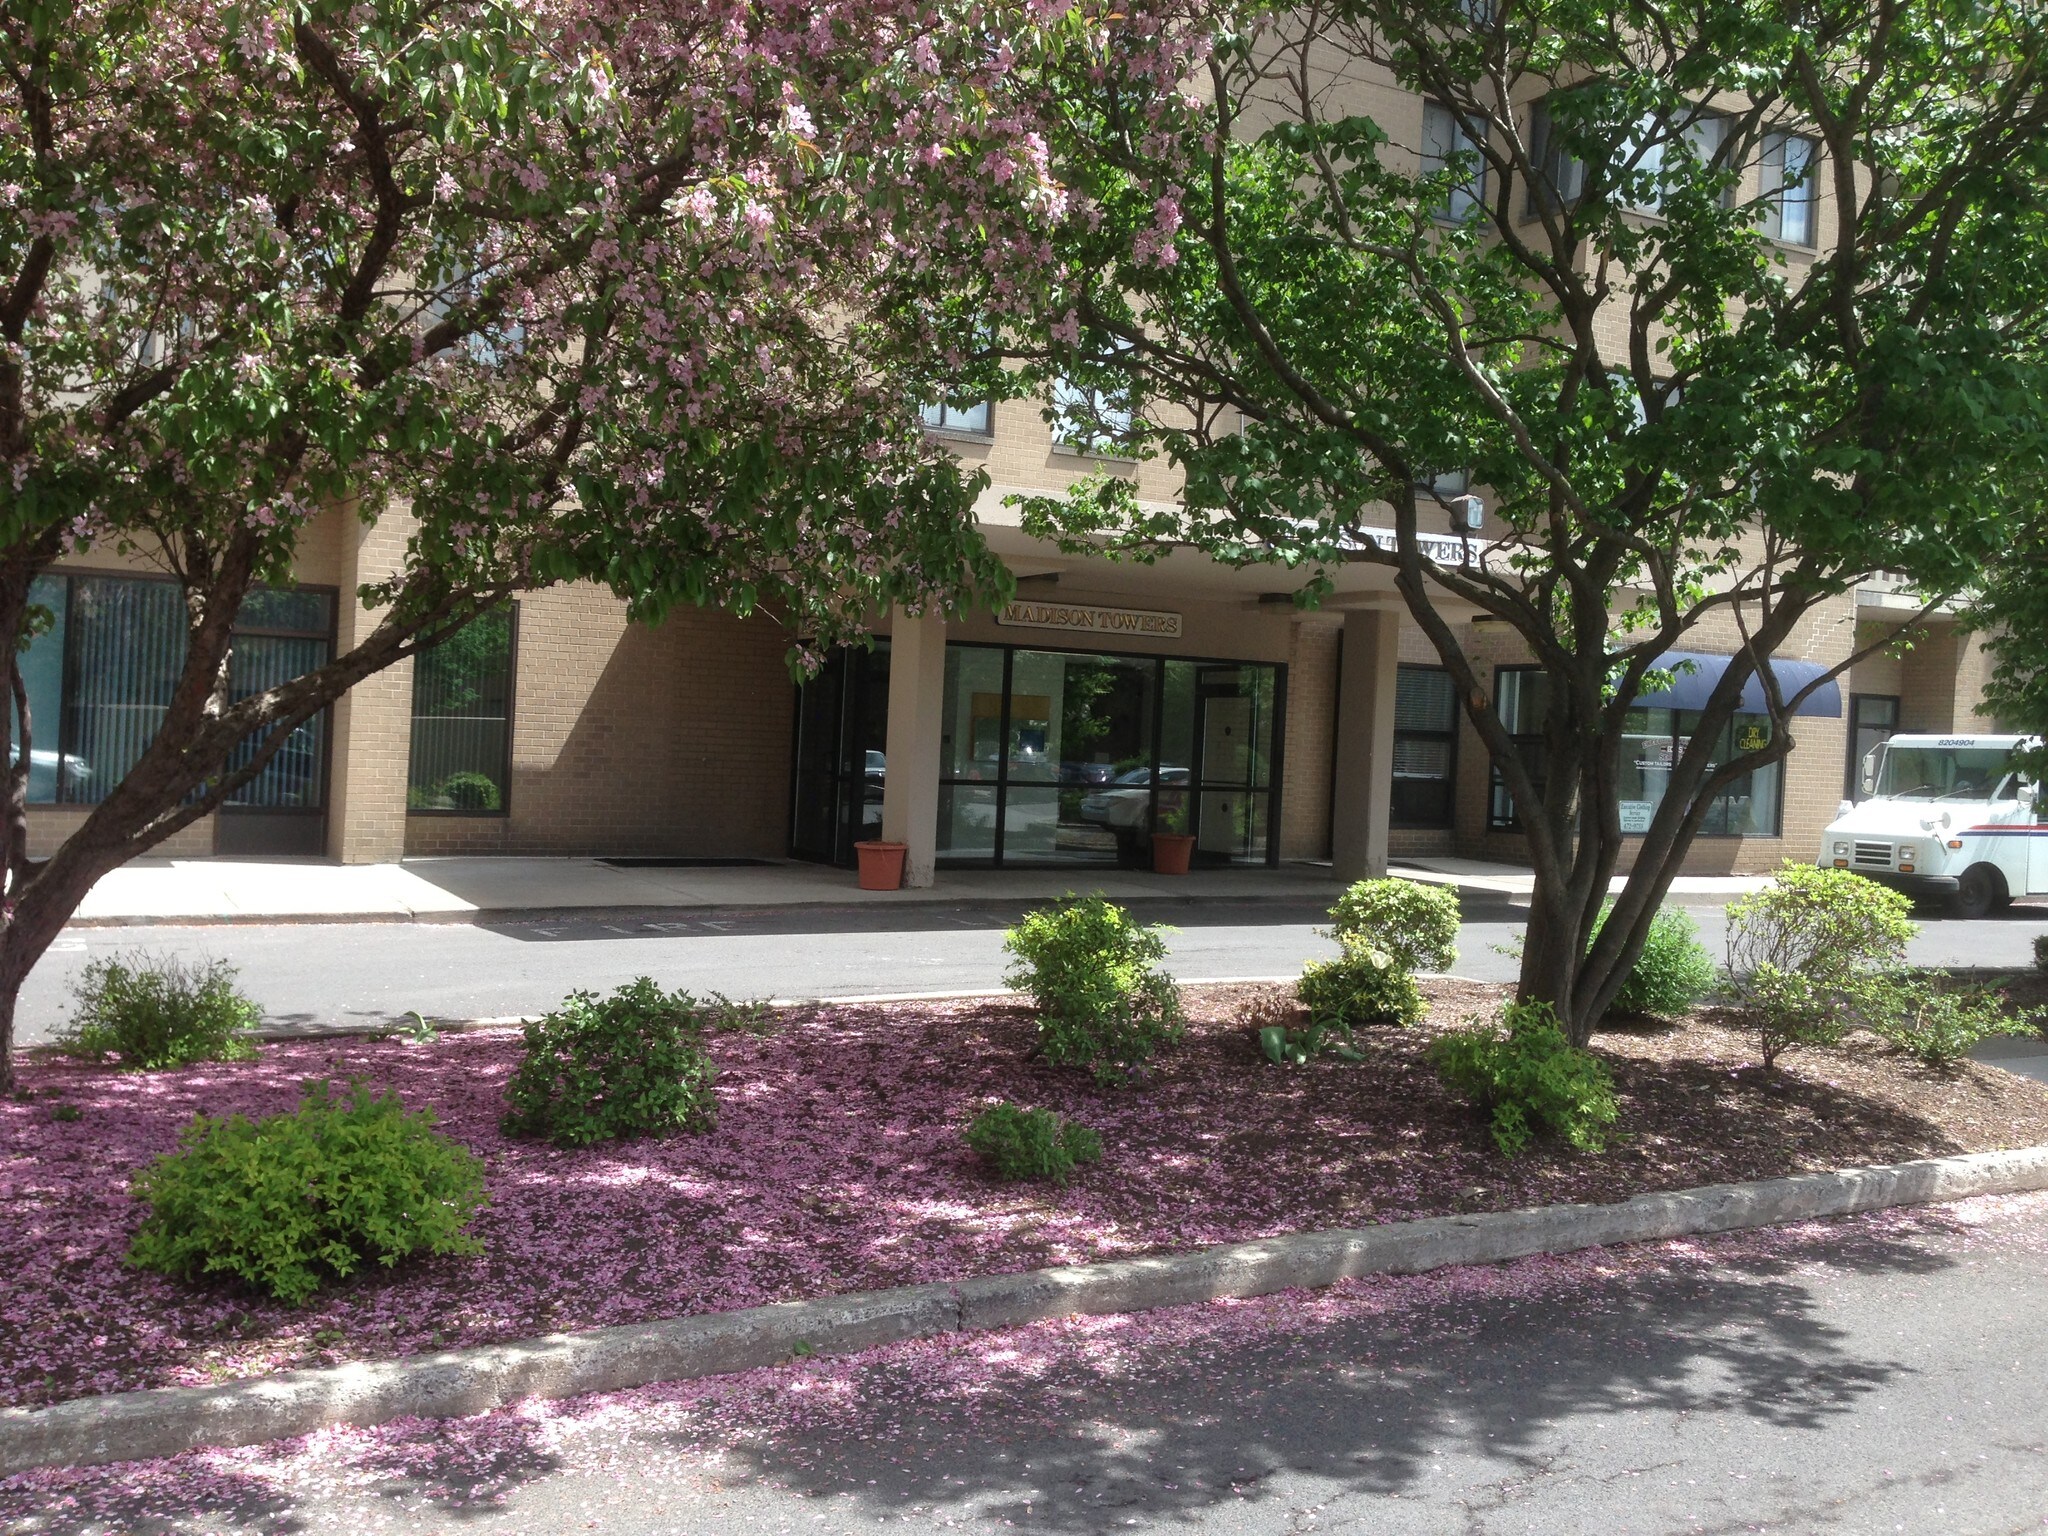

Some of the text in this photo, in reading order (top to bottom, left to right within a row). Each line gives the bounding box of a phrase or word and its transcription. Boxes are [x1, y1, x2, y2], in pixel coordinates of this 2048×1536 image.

[1387, 534, 1478, 564] TWERS
[1003, 604, 1178, 634] MADISON TOWERS
[1748, 726, 1760, 738] DRY
[1740, 738, 1767, 749] CLEANING
[530, 920, 746, 937] FIRE
